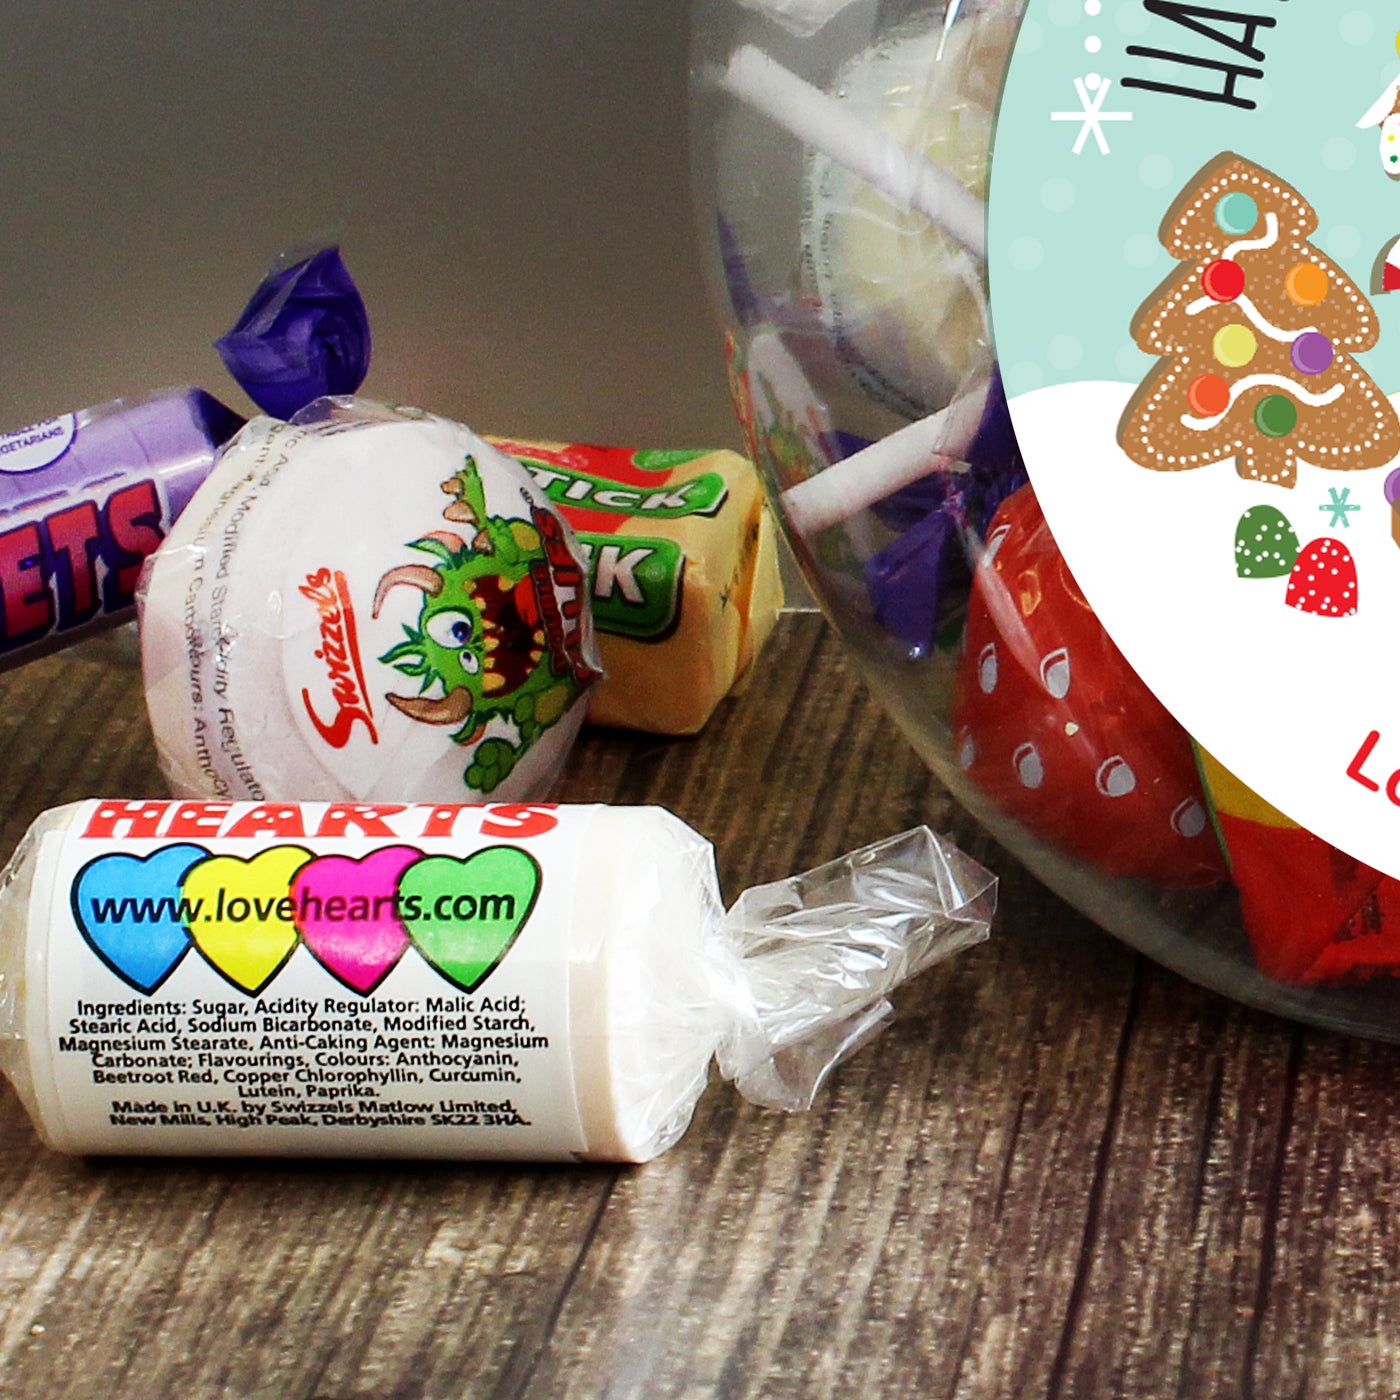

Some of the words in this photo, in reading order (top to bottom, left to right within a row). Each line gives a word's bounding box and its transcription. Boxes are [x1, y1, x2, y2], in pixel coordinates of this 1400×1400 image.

[301, 566, 379, 749] Swizzels
[78, 802, 560, 839] HEARTS
[90, 886, 516, 925] www.lovehearts.com
[78, 1000, 186, 1019] Ingredients:
[192, 1000, 249, 1020] Sugar,
[254, 999, 318, 1018] Acidity
[324, 998, 420, 1016] Regulator:
[426, 997, 474, 1014] Malic
[480, 996, 526, 1015] Acid;
[69, 1018, 132, 1034] Stearic
[137, 1018, 182, 1035] Acid,
[188, 1017, 257, 1033] Sodium
[262, 1016, 378, 1033] Bicarbonate,
[384, 1015, 467, 1032] Modified
[473, 1015, 535, 1032] Starch,
[58, 1036, 166, 1055] Magnesium
[172, 1036, 253, 1052] Stearate,
[260, 1035, 368, 1052] Anti-Caking
[374, 1034, 435, 1052] Agent:
[441, 1033, 549, 1052] Magnesium
[92, 1053, 193, 1069] Carbonate;
[199, 1052, 310, 1070] Flavourings,
[315, 1052, 390, 1067] Colours:
[396, 1052, 519, 1069] Anthocyanin,
[93, 1070, 173, 1084] Beetroot
[178, 1070, 218, 1085] Red,
[223, 1069, 289, 1085] Copper
[295, 1068, 423, 1085] Chlorophyllin,
[429, 1068, 522, 1083] Curcumin,
[238, 1085, 301, 1099] Lutein,
[306, 1085, 380, 1099] Paprika.
[112, 1101, 167, 1113] Made
[174, 1101, 191, 1113] in
[199, 1101, 238, 1113] U.K.
[242, 1101, 266, 1116] by
[271, 1101, 353, 1113] Swizzels
[359, 1100, 433, 1113] Matlow
[440, 1100, 517, 1114] Limited,
[110, 1115, 156, 1126] New
[161, 1115, 212, 1126] Mills,
[216, 1115, 261, 1127] High
[266, 1115, 318, 1126] Peak,
[322, 1114, 425, 1128] Derbyshire
[431, 1114, 480, 1126] SK22
[484, 1114, 532, 1126] 3HA.
